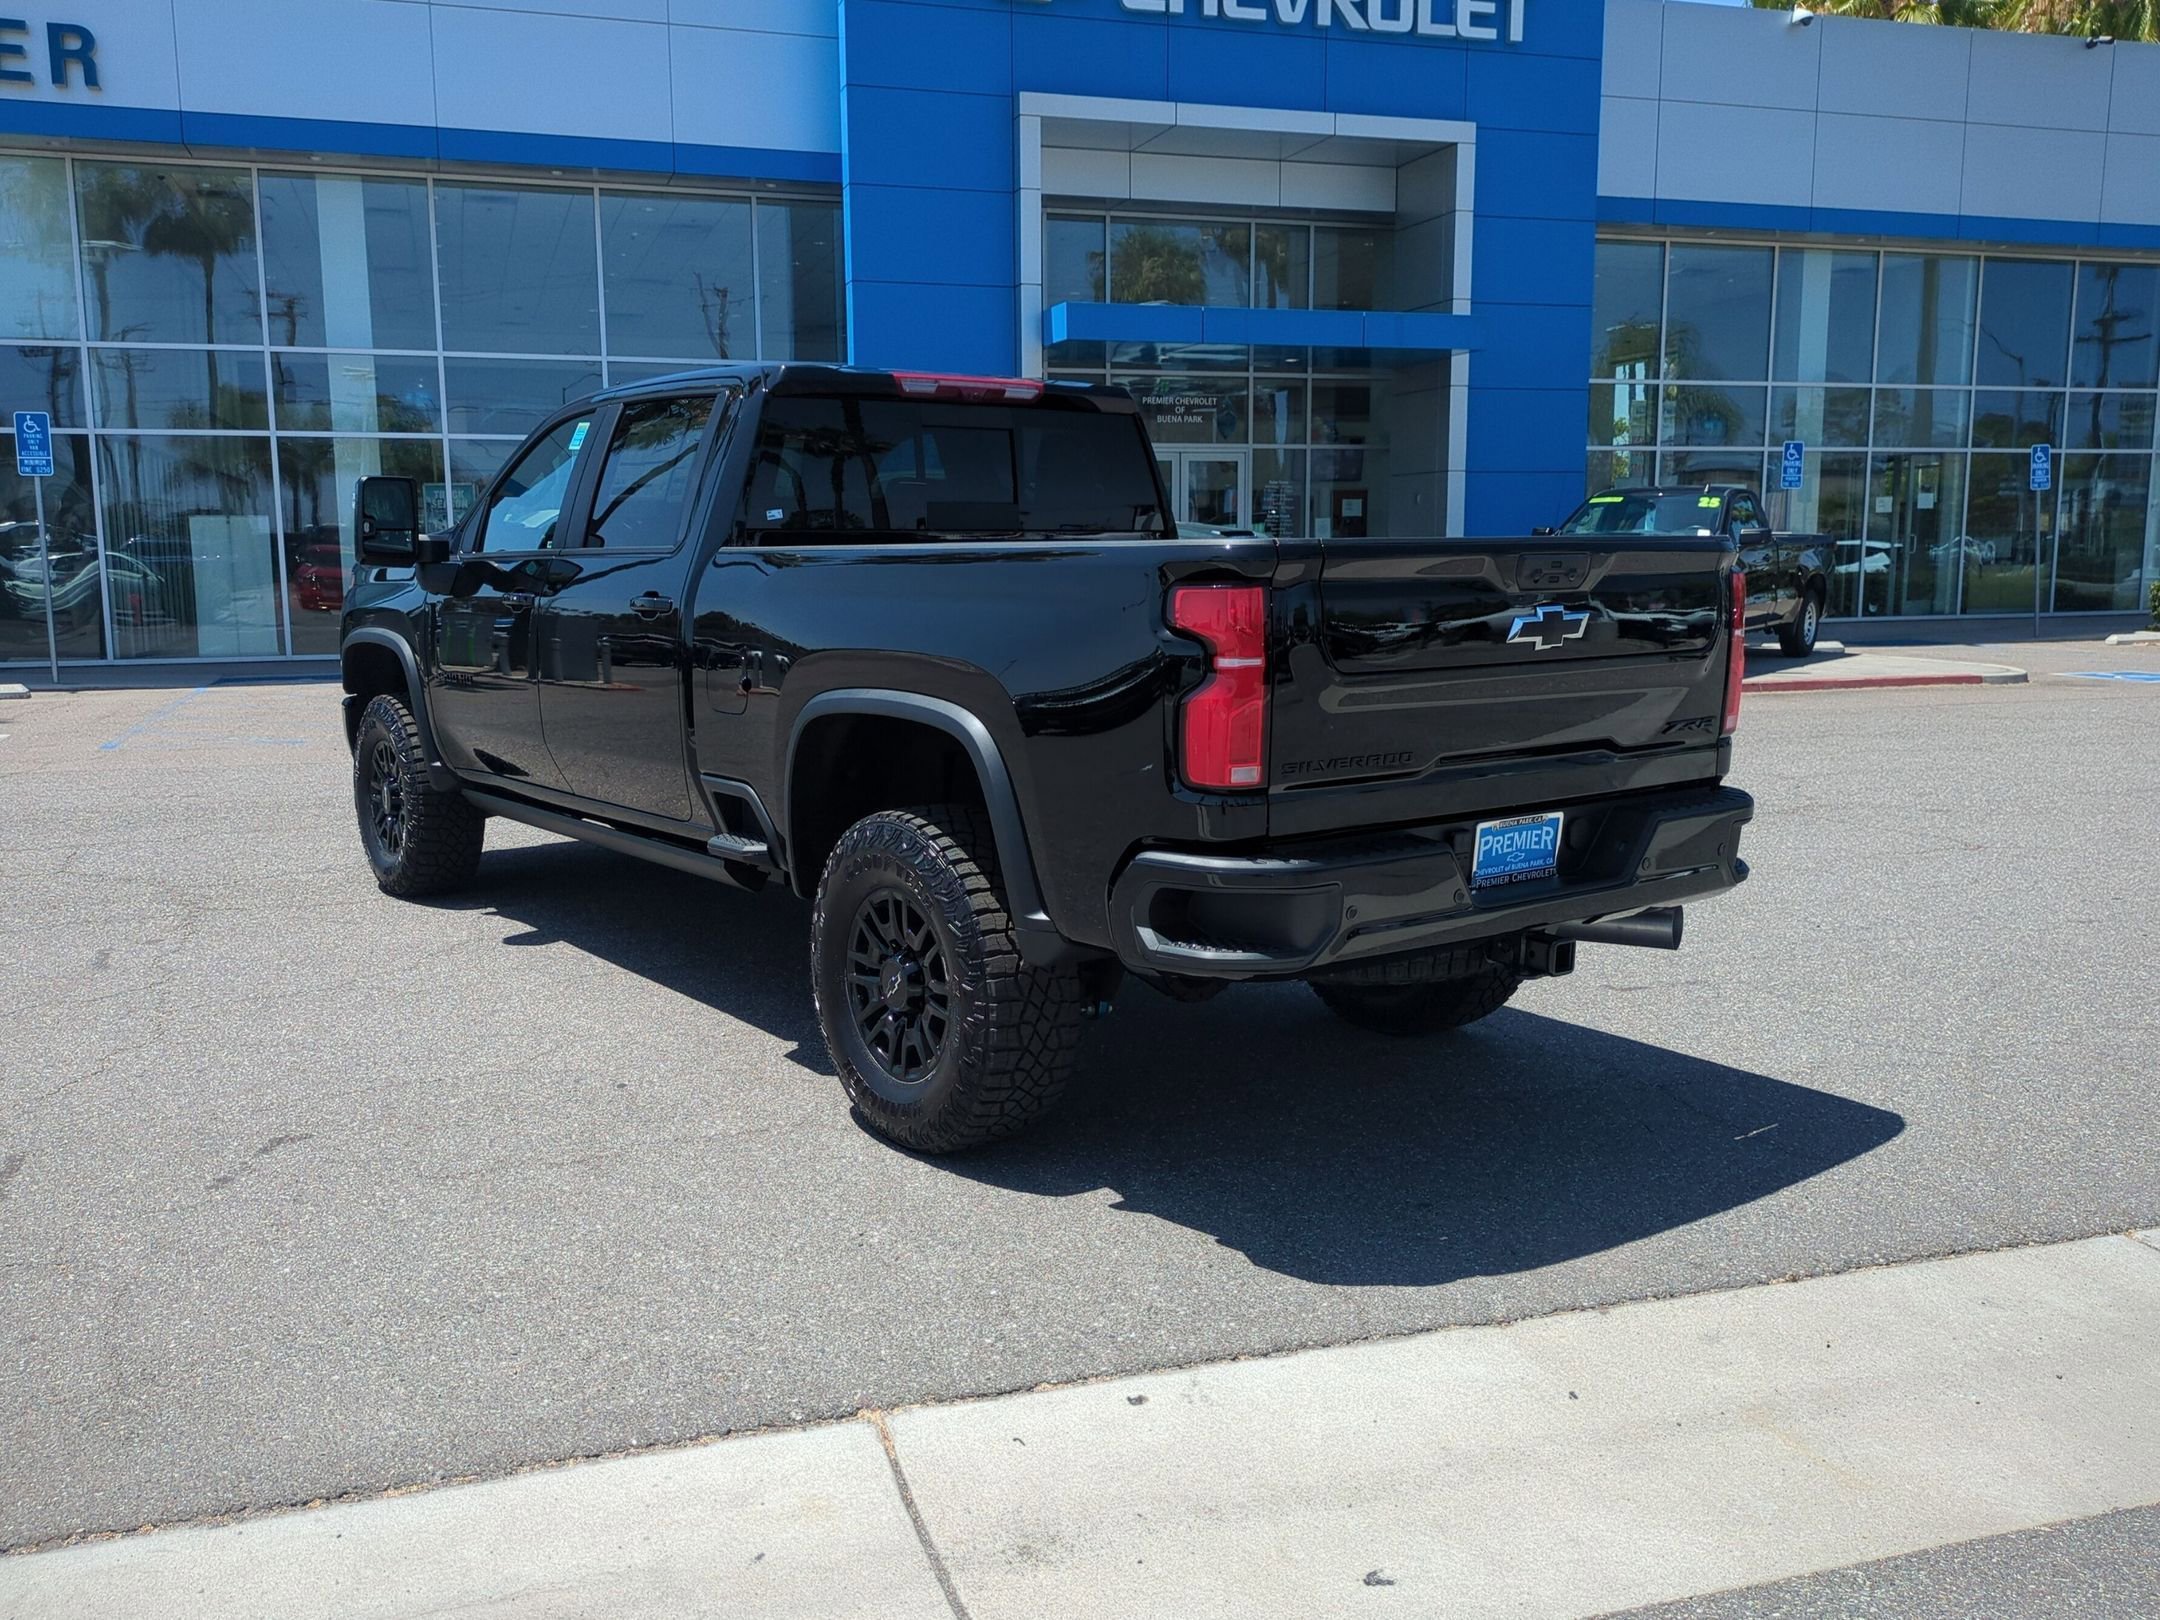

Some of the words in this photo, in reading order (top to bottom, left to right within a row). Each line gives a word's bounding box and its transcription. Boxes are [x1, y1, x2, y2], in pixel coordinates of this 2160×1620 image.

[1142, 396, 1174, 405] PREMIER
[1175, 397, 1217, 405] CHEVROLET
[1175, 406, 1185, 414] OF
[1157, 415, 1182, 423] BUENA
[1183, 415, 1203, 423] PARK
[1697, 496, 1721, 508] 25
[1280, 751, 1414, 776] SILVERADO
[1478, 826, 1554, 862] PREMIER
[1511, 861, 1530, 871] BUENA
[1476, 874, 1510, 889] PREMIER
[1511, 868, 1554, 883] CHEVROLET
